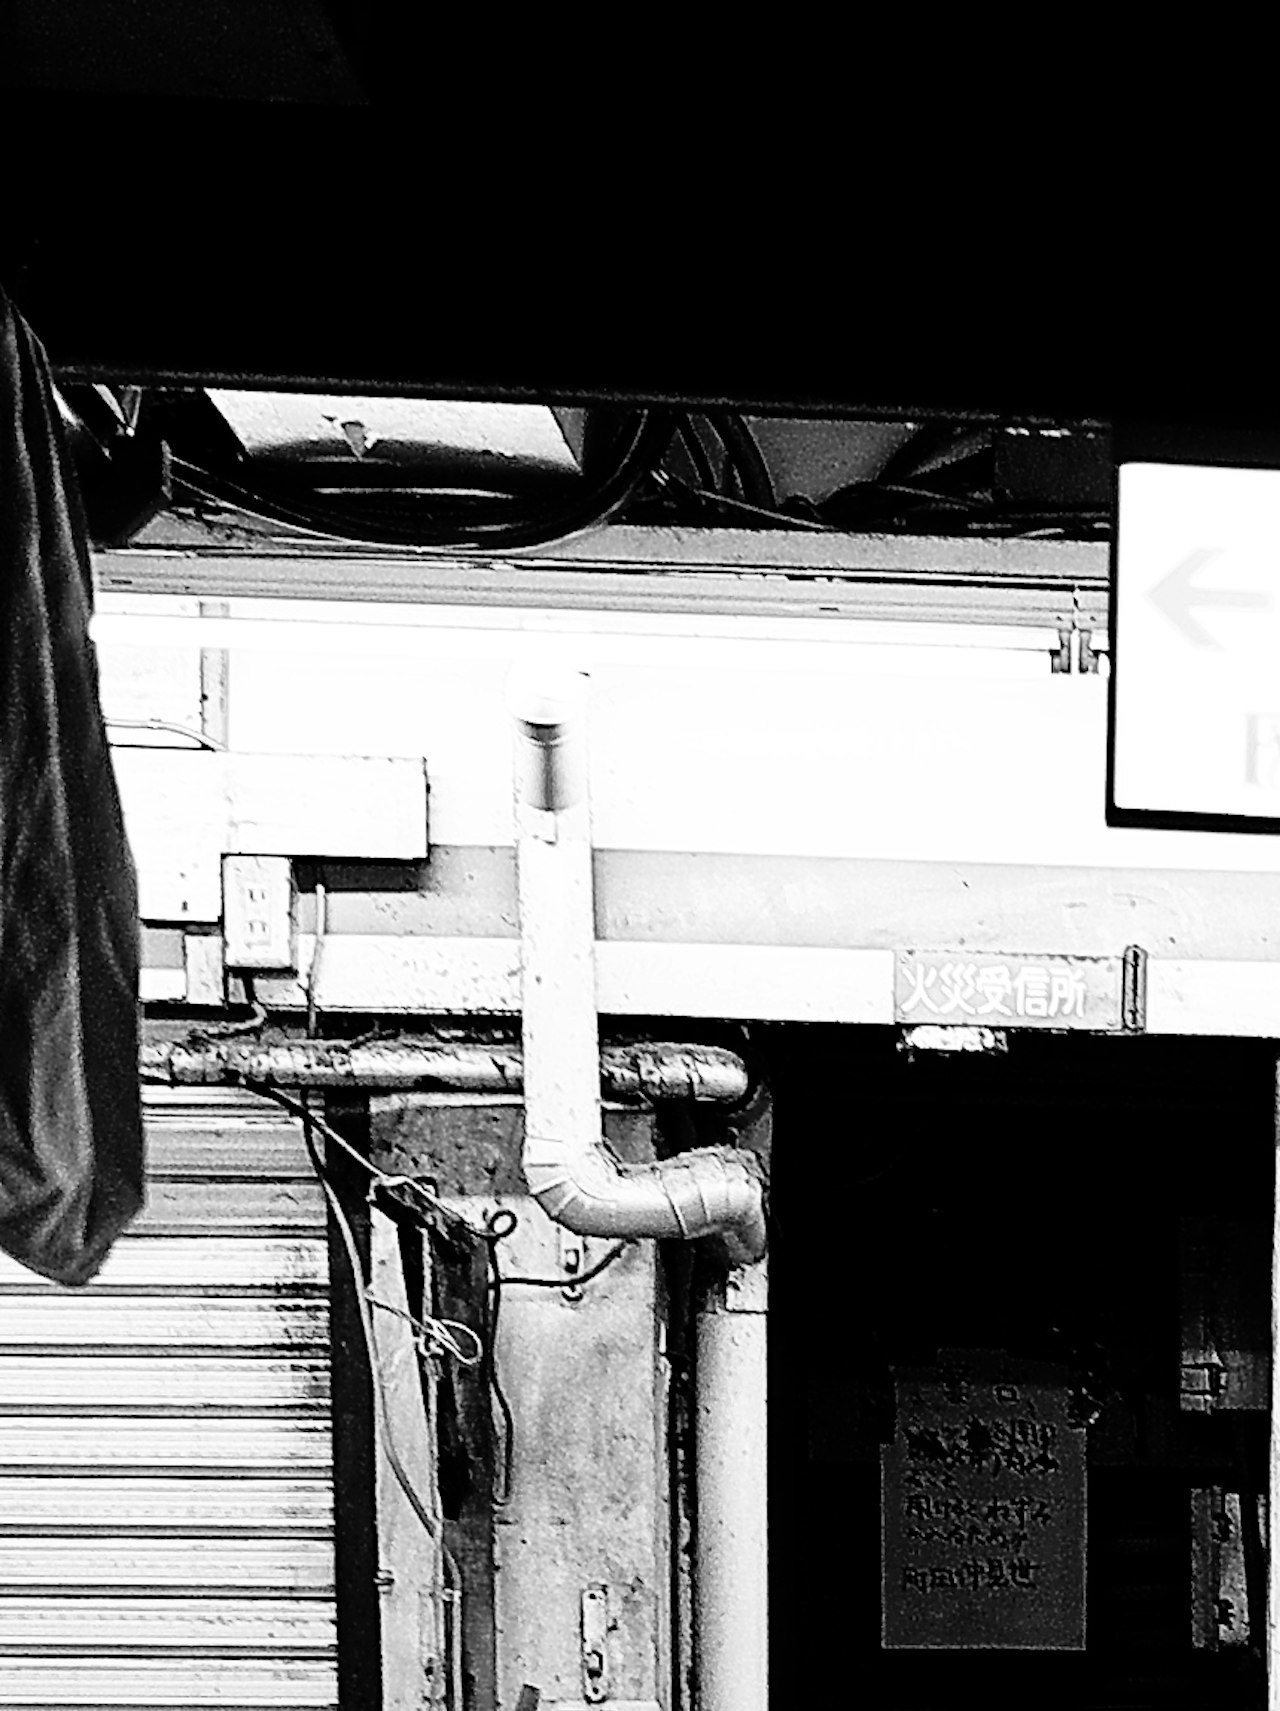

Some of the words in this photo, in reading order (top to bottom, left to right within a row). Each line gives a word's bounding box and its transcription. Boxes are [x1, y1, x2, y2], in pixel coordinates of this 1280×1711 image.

[900, 963, 1087, 1017] 火災受信所
